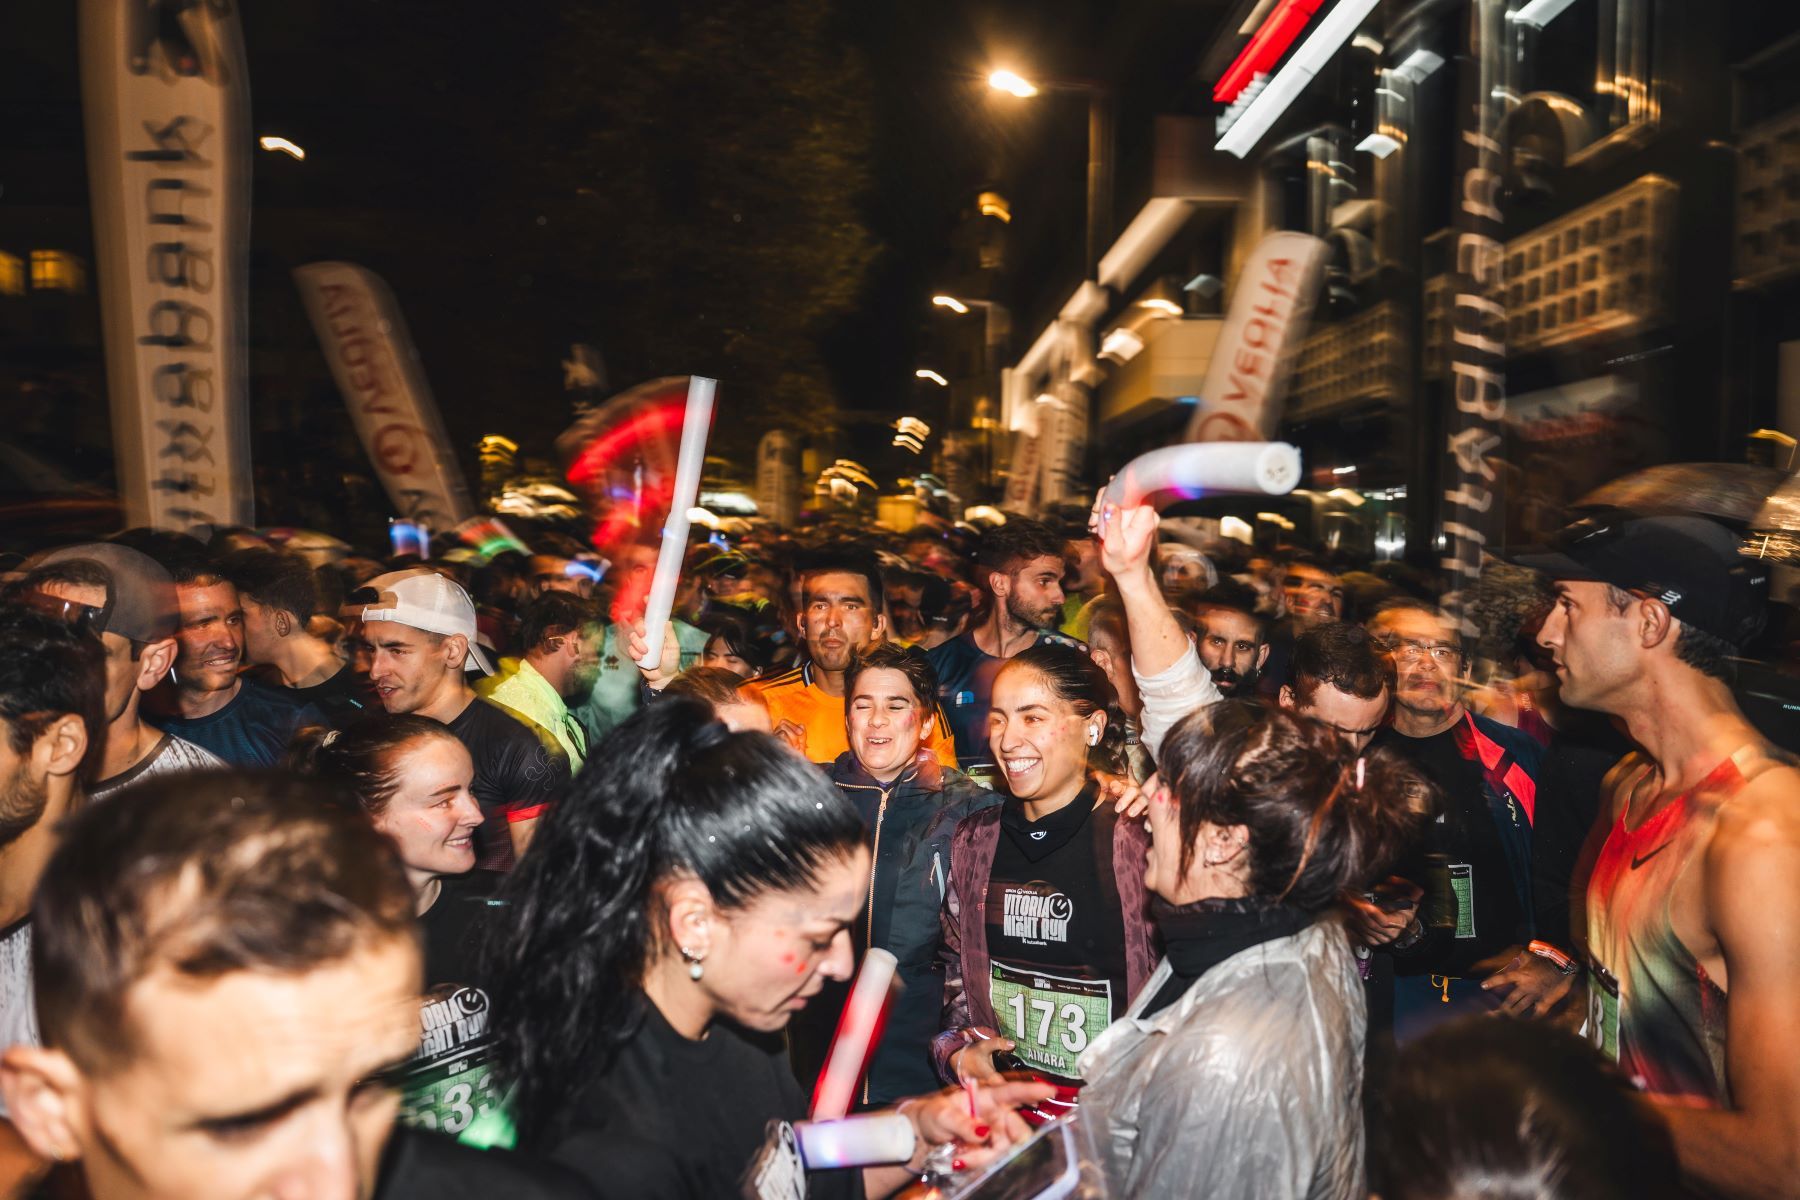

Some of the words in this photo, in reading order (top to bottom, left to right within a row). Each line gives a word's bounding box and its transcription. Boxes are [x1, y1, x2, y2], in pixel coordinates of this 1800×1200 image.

[1222, 258, 1297, 404] VEOLIA
[1004, 893, 1051, 919] VITORIA
[1003, 914, 1039, 940] NIGHT
[1040, 918, 1067, 943] RUN
[420, 998, 465, 1032] ORIA
[1008, 991, 1088, 1053] 173
[1027, 1047, 1066, 1069] AINARA
